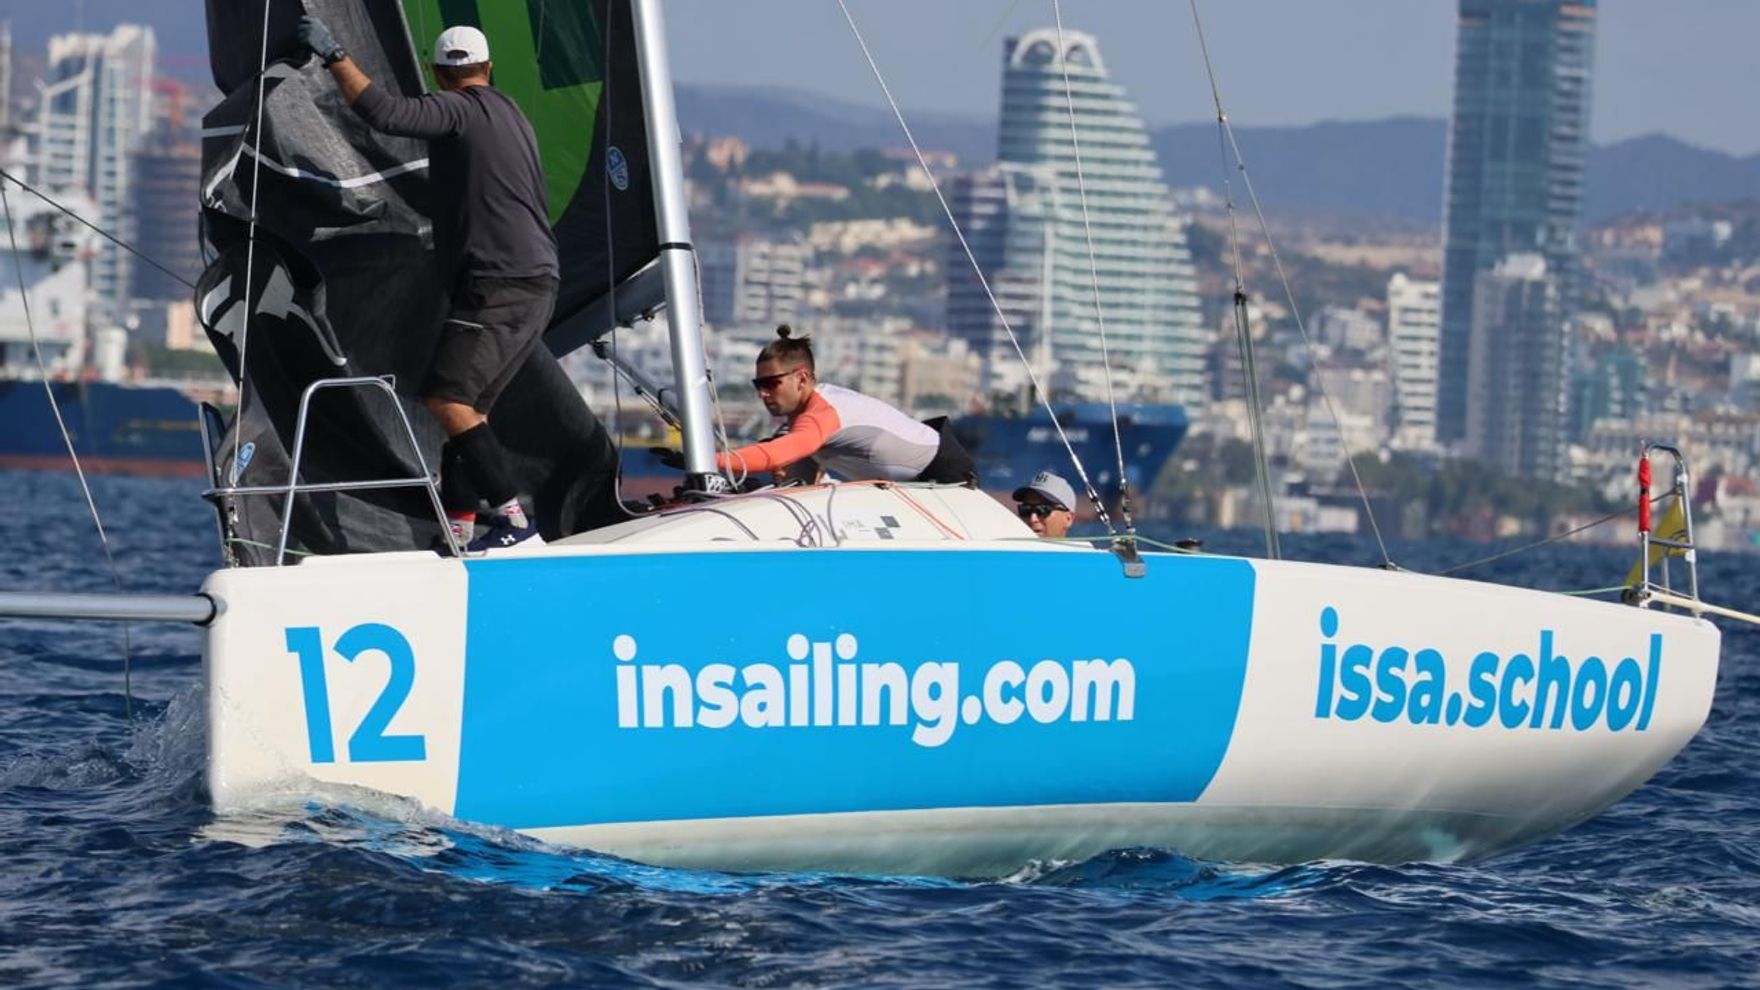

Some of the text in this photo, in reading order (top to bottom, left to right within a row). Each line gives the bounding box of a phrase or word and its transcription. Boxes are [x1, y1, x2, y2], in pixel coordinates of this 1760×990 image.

[285, 622, 427, 764] 12
[613, 634, 1136, 747] insailing.com
[1315, 606, 1663, 732] issa.school
